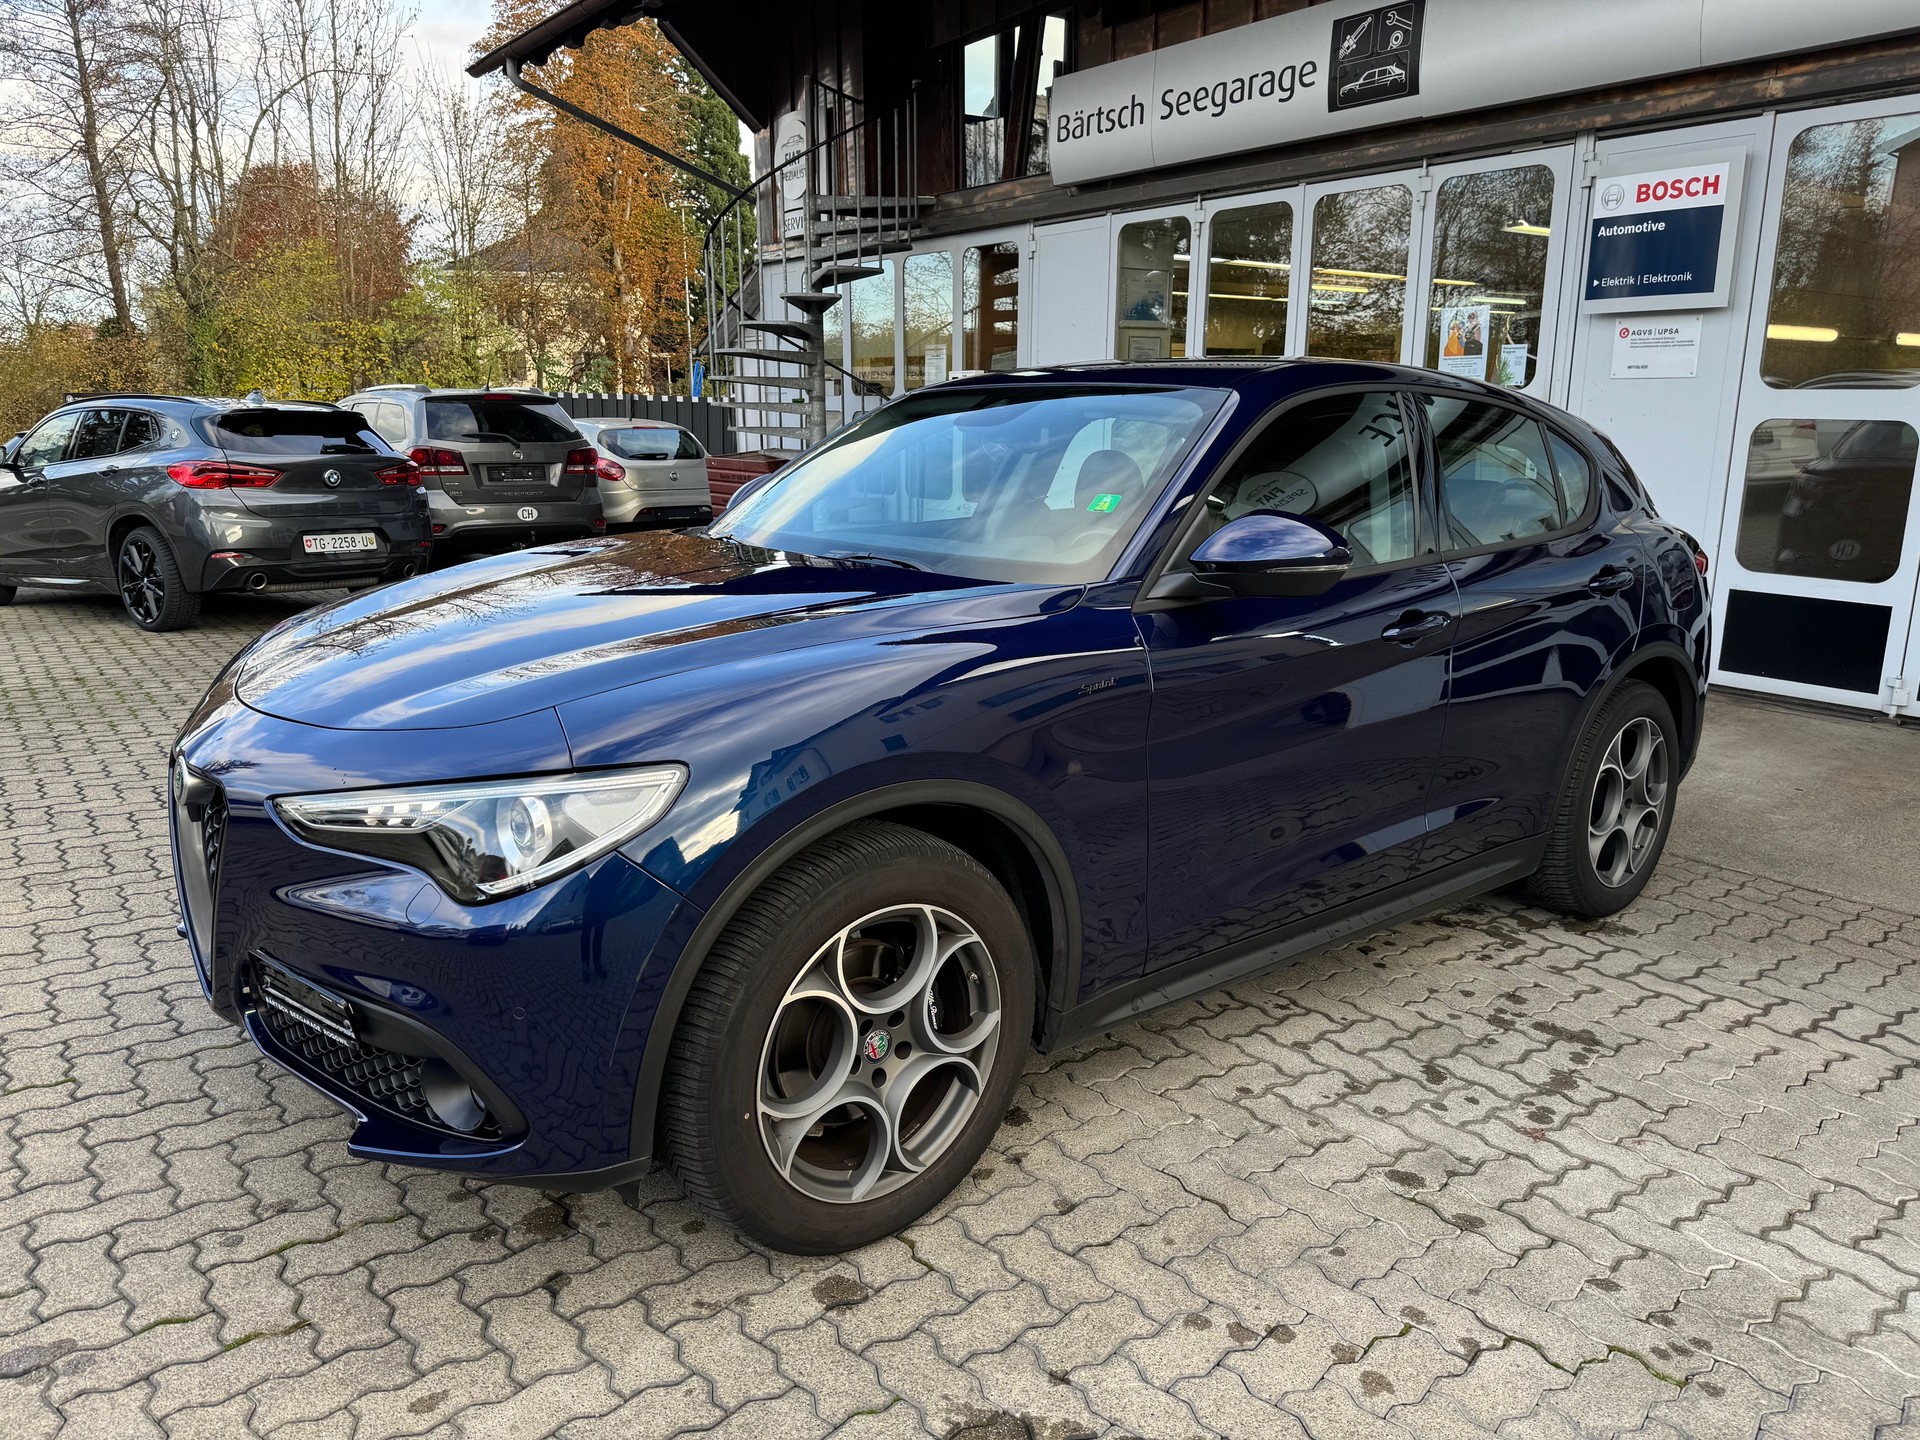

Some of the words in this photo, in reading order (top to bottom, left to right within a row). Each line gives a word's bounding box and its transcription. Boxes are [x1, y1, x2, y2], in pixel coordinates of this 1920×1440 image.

[1056, 94, 1145, 143] Bärtsch
[1160, 60, 1318, 119] Seegarage
[783, 168, 806, 182] PEZIALIS
[1636, 175, 1720, 203] BOSCH
[784, 216, 804, 233] SERVI
[1598, 221, 1666, 237] Automotive
[1601, 276, 1635, 287] Elektrik
[1643, 272, 1693, 284] Elektronik
[521, 509, 534, 519] CH
